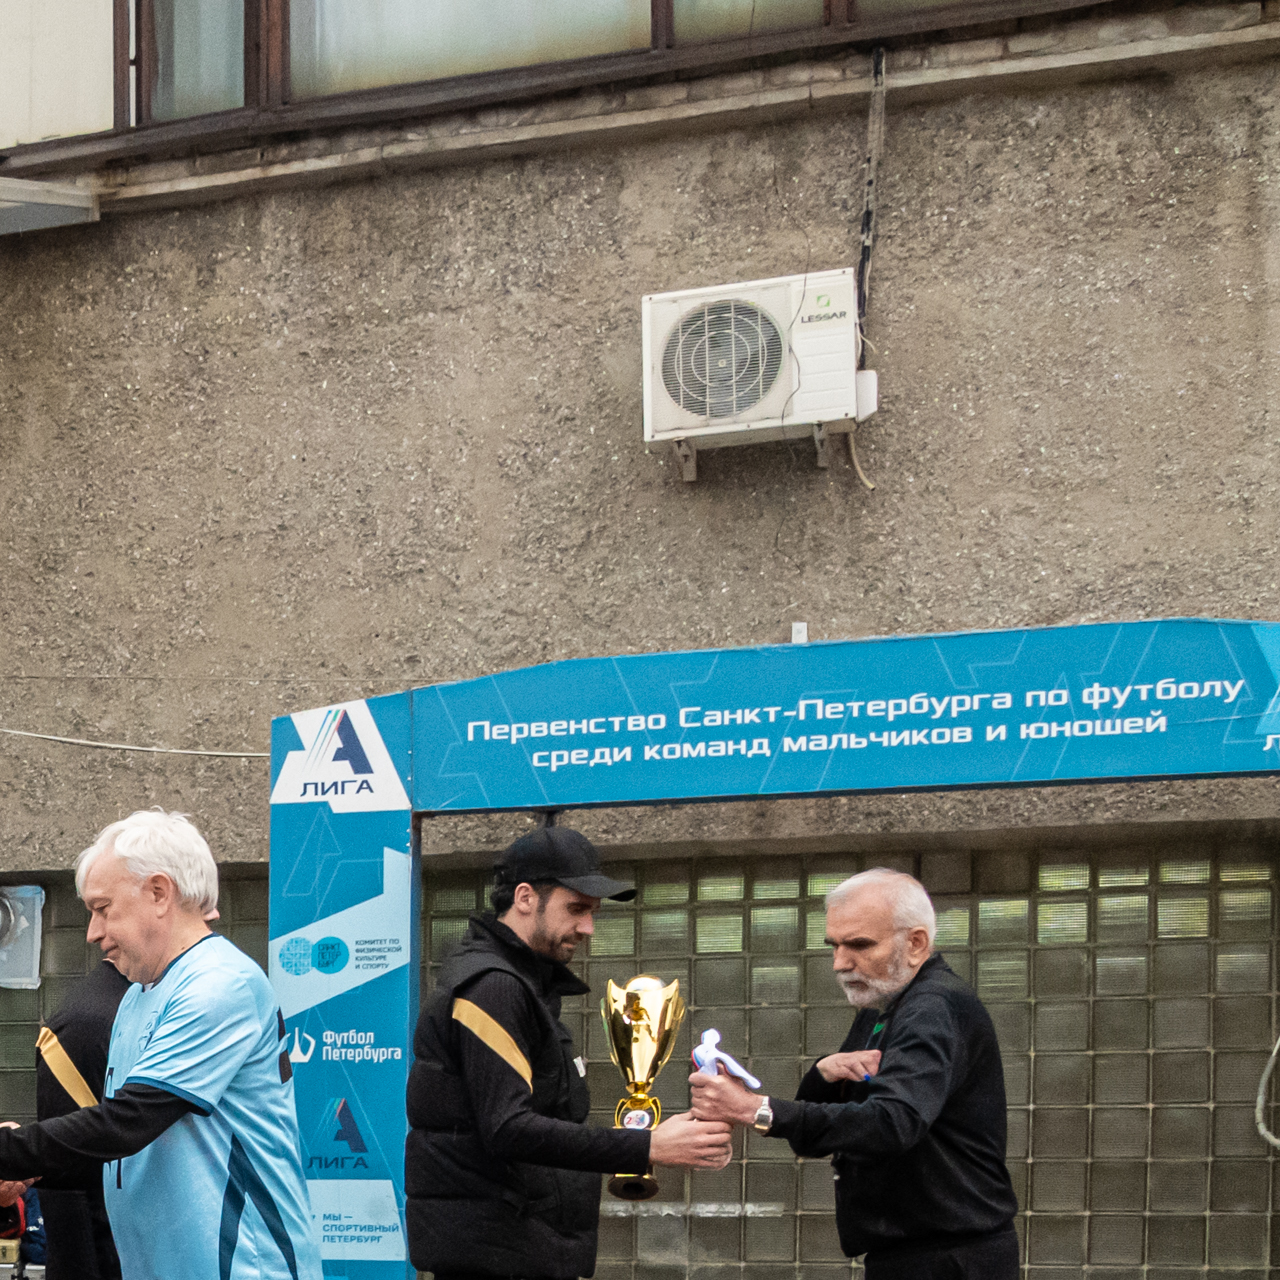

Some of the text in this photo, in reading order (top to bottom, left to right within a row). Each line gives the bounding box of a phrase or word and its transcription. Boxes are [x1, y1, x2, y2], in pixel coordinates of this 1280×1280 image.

[801, 311, 847, 323] LESSAR
[467, 678, 1245, 744] Первенство Санкт-Петербурга по футболу
[532, 711, 1167, 772] среди команд мальчиков и юношей
[300, 780, 374, 797] ЛИГА
[355, 945, 402, 953] ФИЗИЧЕСКОЙ
[322, 1029, 374, 1047] Футбол
[322, 1045, 402, 1063] Петербурга
[307, 1156, 368, 1169] ЛИГА
[323, 1223, 399, 1232] СПОРТИВНЫЙ
[323, 1235, 383, 1243] ПЕТЕРБУРГ
